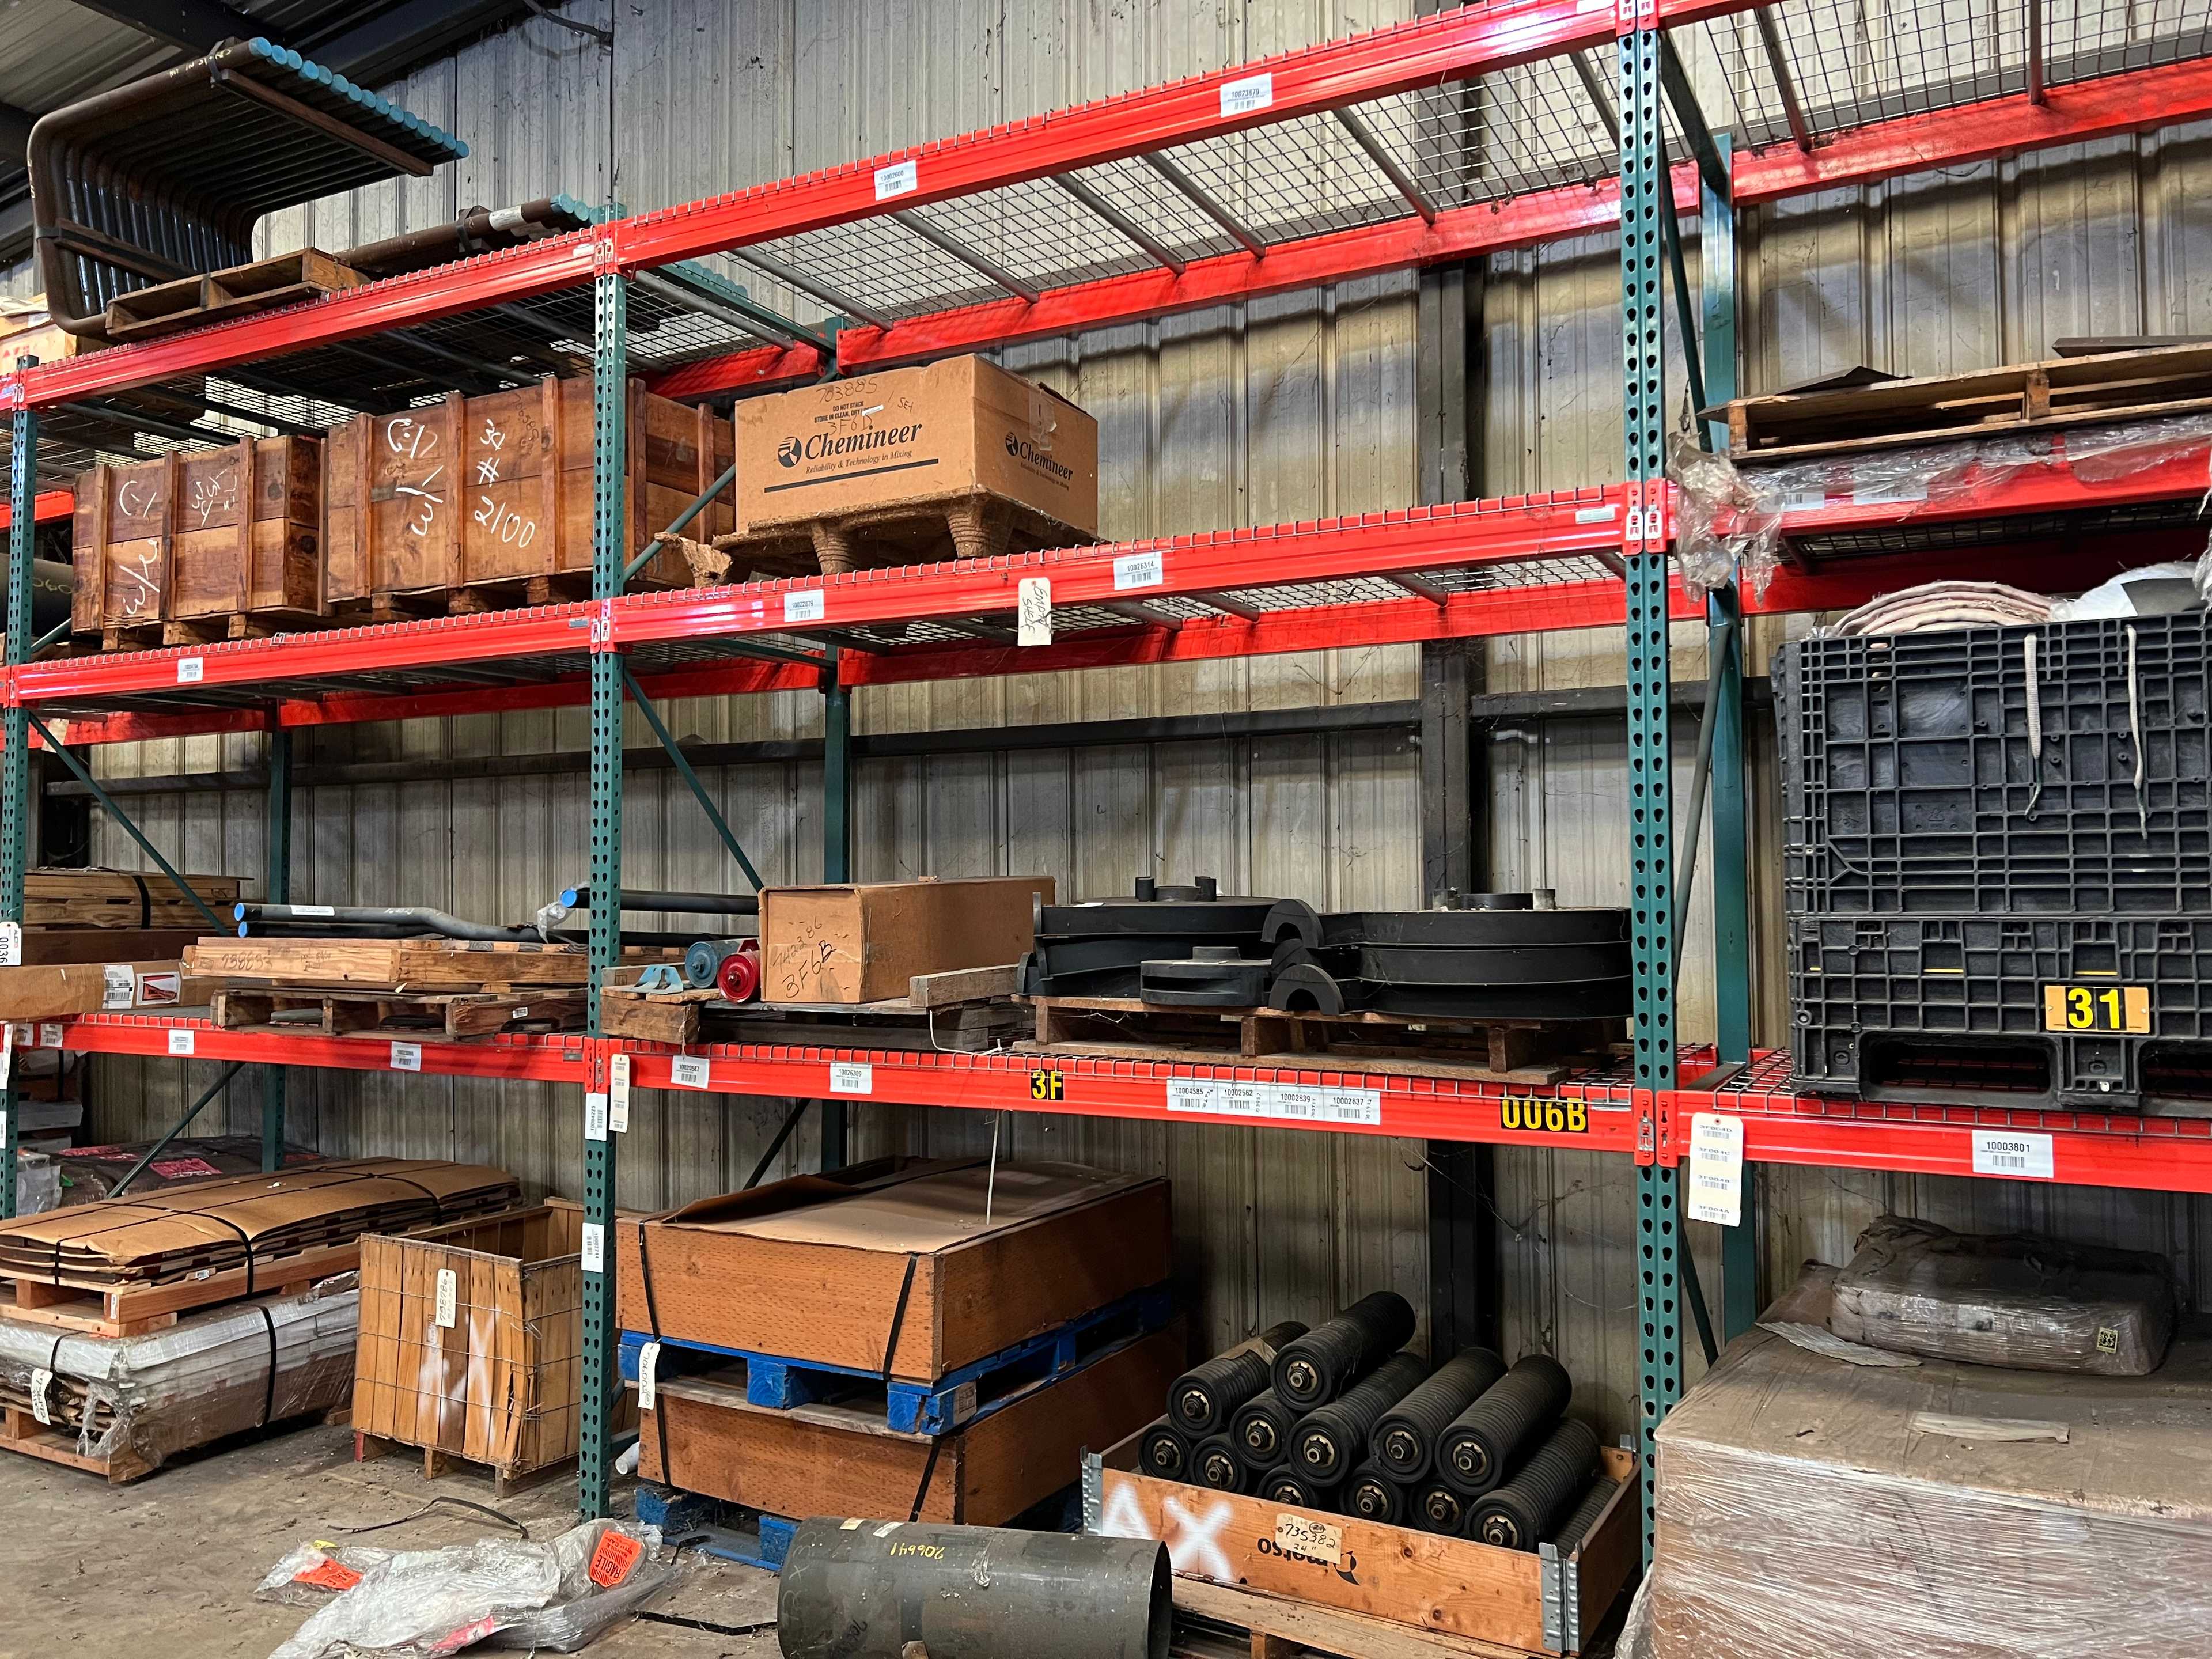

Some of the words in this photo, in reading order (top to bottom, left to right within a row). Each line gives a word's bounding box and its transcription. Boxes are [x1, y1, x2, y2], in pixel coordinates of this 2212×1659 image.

[850, 400, 864, 410] STACK
[814, 415, 828, 423] STORE
[805, 423, 922, 460] Chemineer
[806, 462, 836, 475] Reliability
[838, 460, 844, 468] &
[845, 454, 880, 467] Technology
[890, 450, 912, 460] Mixing
[1020, 442, 1074, 481] Chemineer
[2067, 987, 2120, 1029] 31
[1032, 1070, 1062, 1100] 3F
[1986, 1141, 2030, 1152] 10003801
[1285, 1524, 1336, 1549] 735382
